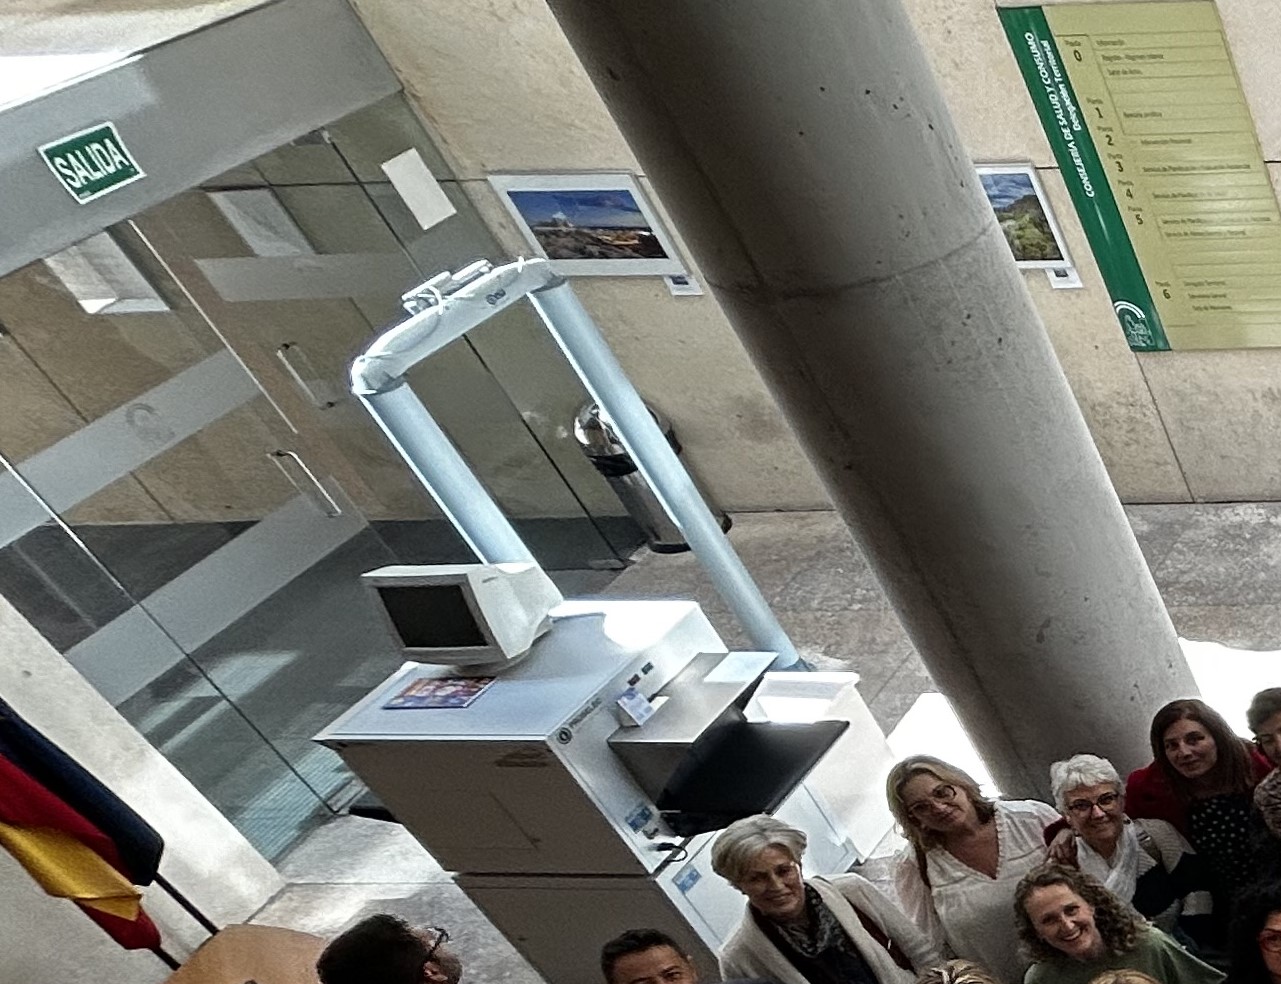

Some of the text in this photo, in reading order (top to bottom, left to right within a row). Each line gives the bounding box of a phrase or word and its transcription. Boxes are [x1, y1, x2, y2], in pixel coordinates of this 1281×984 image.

[1024, 31, 1052, 85] CONSUMO
[1040, 40, 1063, 83] Territorial
[1073, 49, 1082, 62] 0
[1049, 93, 1068, 127] SALUD
[1095, 106, 1104, 119] 1
[1061, 127, 1074, 141] DE
[1104, 134, 1115, 146] 2
[53, 138, 130, 189] SALIDA
[1115, 160, 1124, 172] 3
[1125, 188, 1134, 199] 4
[1135, 213, 1144, 225] 5
[1162, 288, 1171, 299] 6
